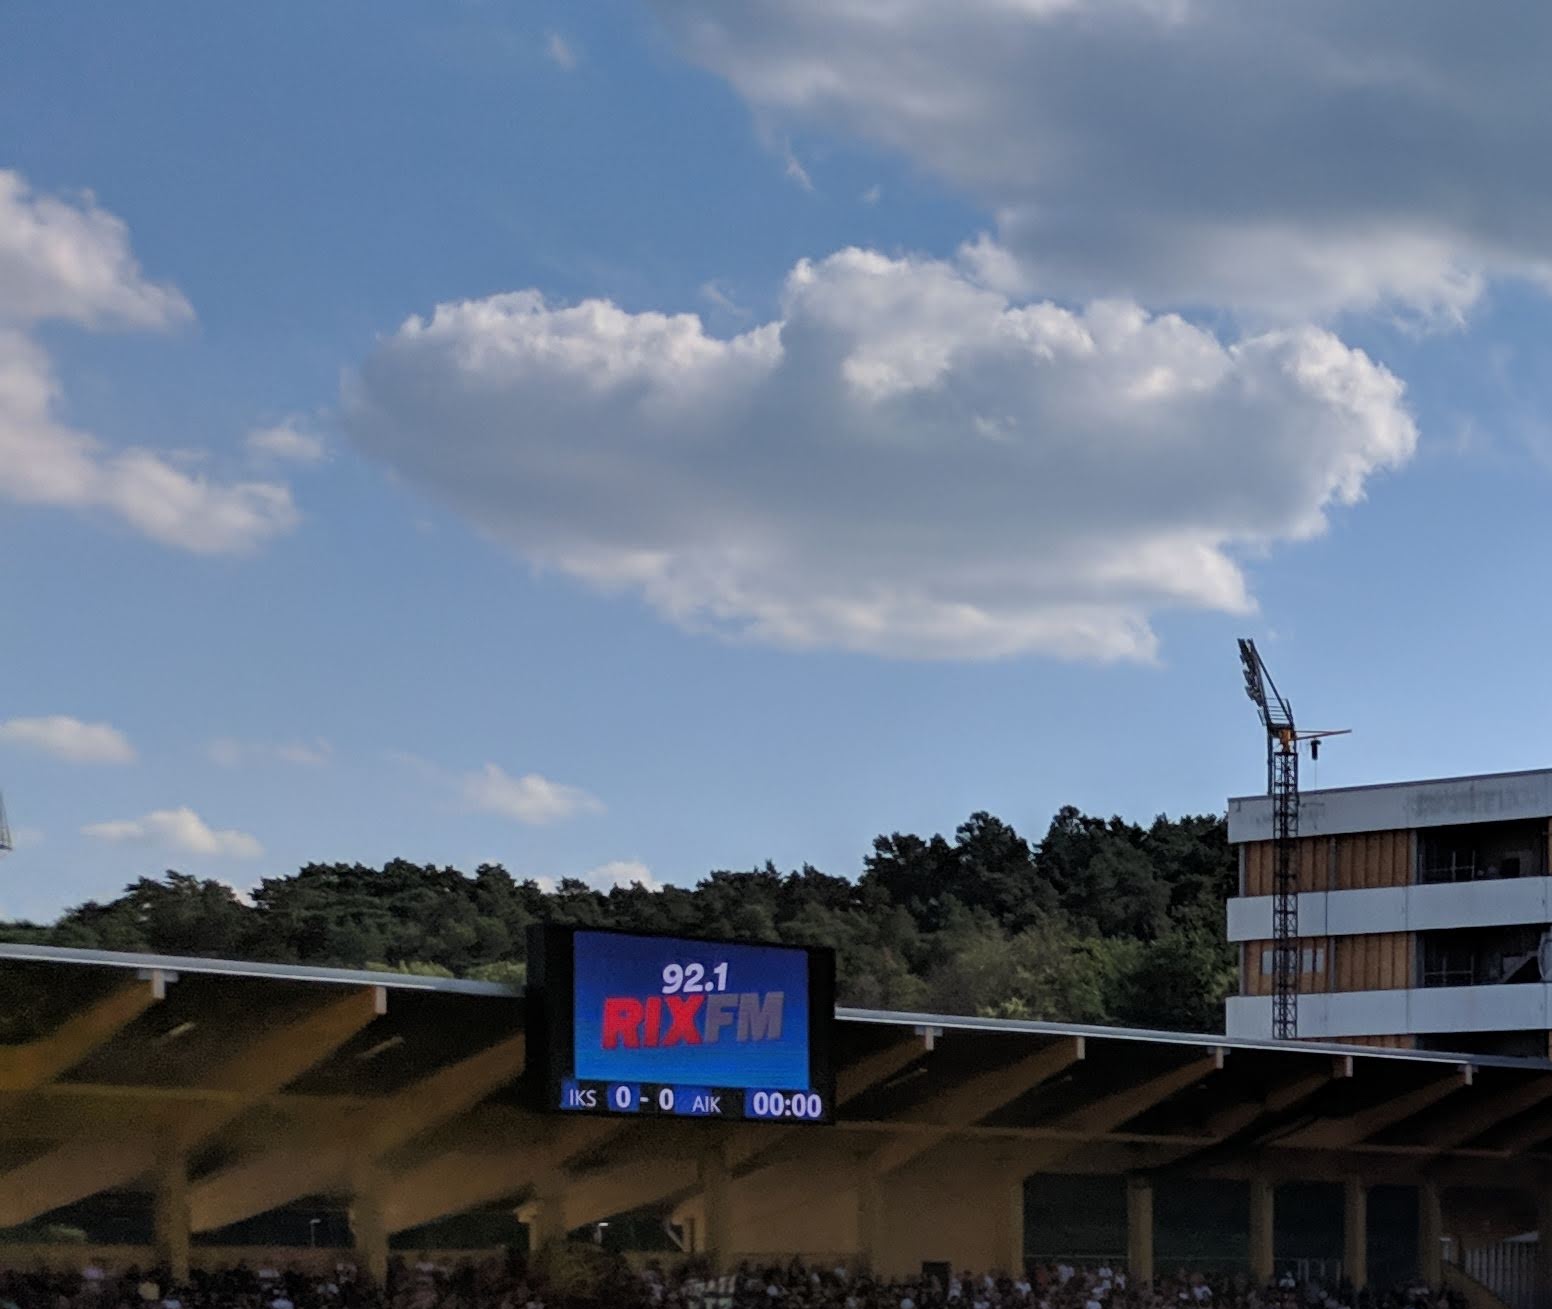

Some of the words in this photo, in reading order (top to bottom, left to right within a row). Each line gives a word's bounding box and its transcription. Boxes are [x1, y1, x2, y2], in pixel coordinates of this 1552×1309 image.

[662, 962, 728, 993] 92.1
[569, 1090, 597, 1107] IKS
[692, 1096, 721, 1113] AIK
[753, 1092, 822, 1117] 00:00
